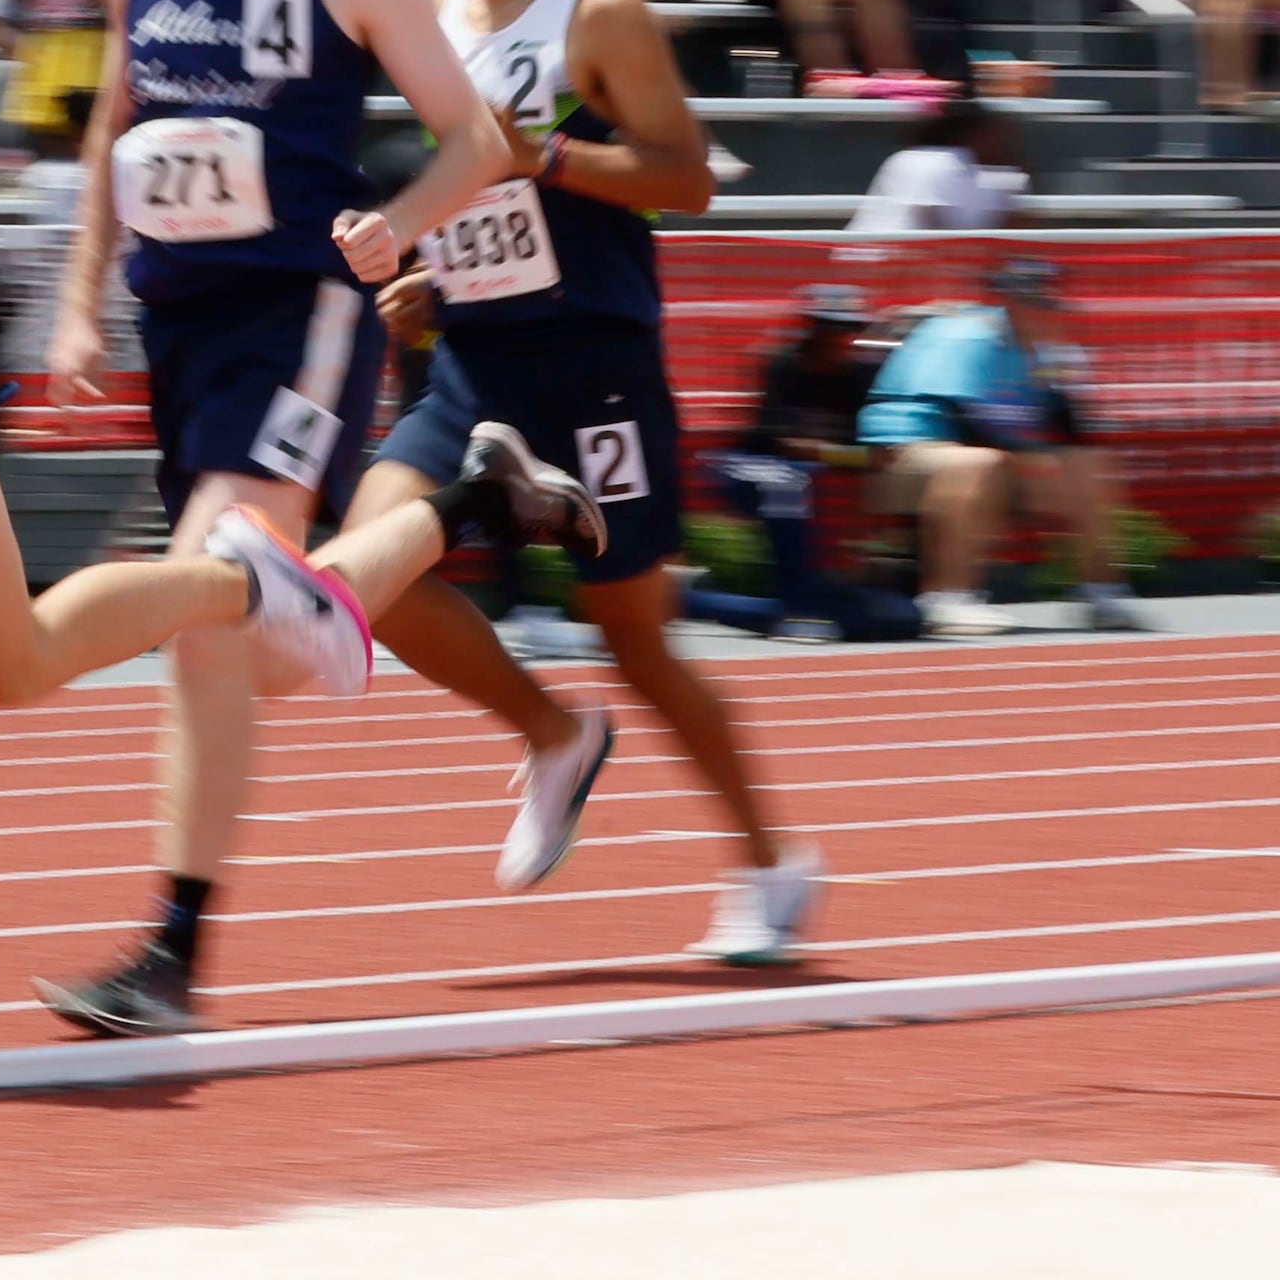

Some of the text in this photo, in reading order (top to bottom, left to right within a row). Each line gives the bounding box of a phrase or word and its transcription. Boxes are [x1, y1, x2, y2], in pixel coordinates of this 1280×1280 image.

[507, 53, 542, 119] 2
[142, 152, 237, 208] 271
[434, 210, 538, 272] 1938
[590, 430, 633, 495] 2
